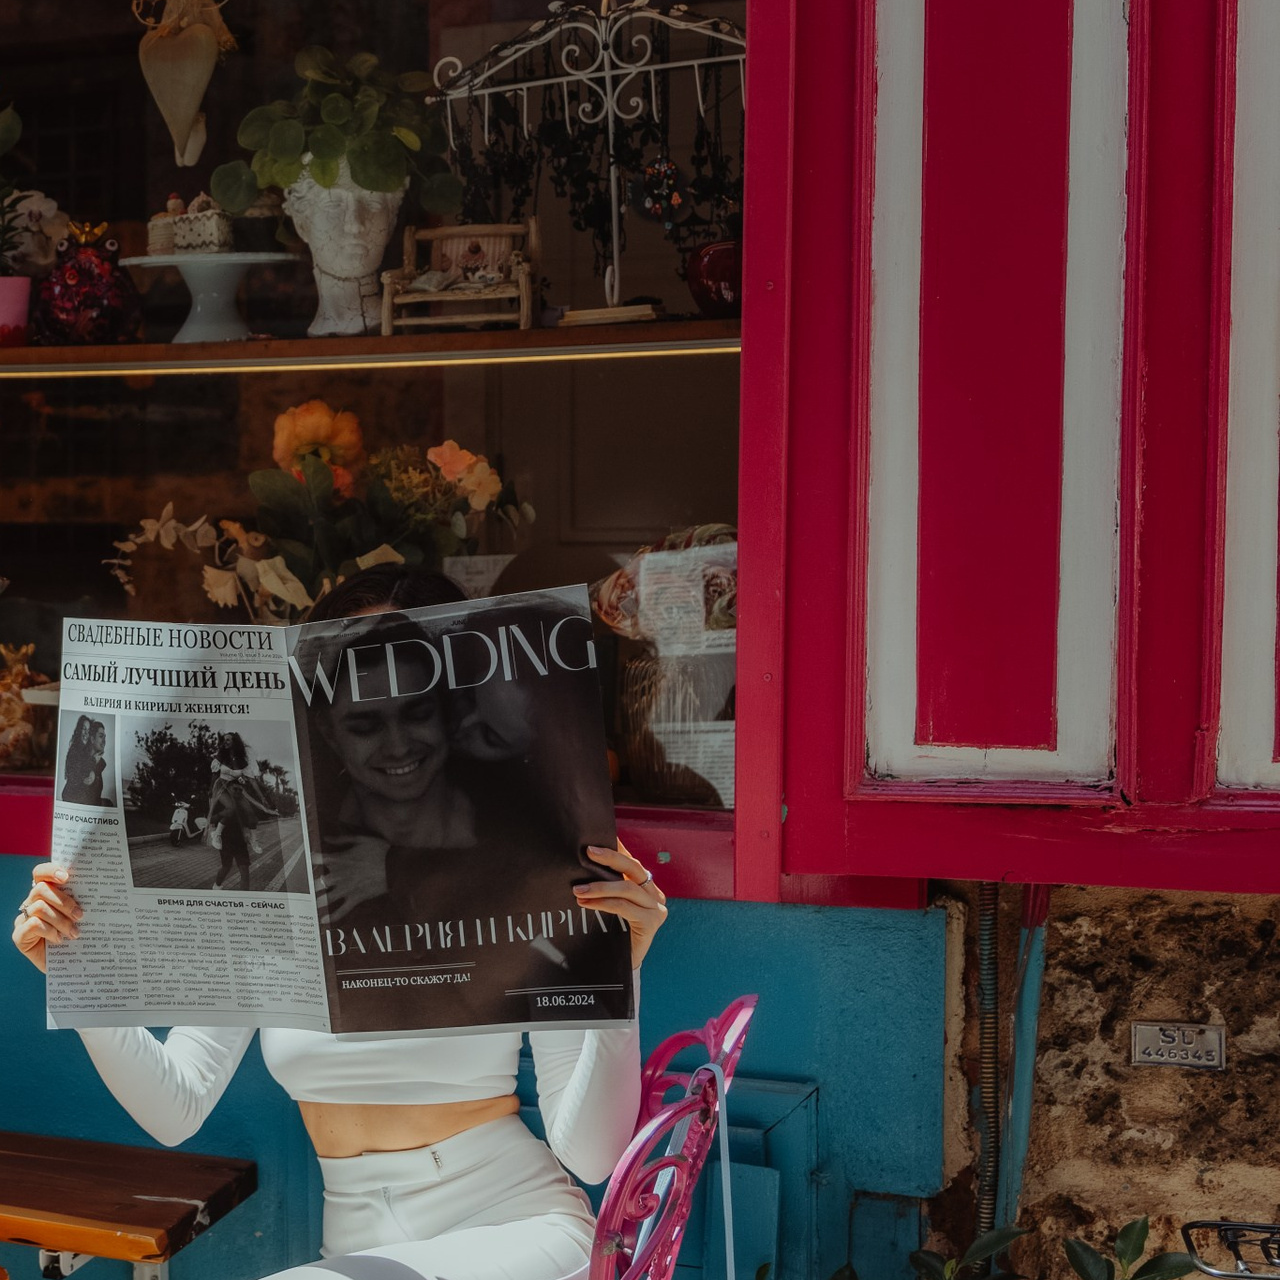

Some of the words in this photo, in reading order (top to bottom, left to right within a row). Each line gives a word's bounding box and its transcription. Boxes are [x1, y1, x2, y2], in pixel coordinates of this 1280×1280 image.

[67, 623, 164, 647] СВАДЕБНЫЕ
[168, 628, 274, 651] НОВОСТИ
[287, 615, 597, 707] WEDDING
[63, 661, 118, 684] САМЫЙ
[121, 665, 218, 689] ЛУЧШИЙ
[223, 670, 286, 692] ДЕНЬ
[83, 696, 122, 709] ВАЛЕРИЯ
[124, 700, 132, 710] И
[134, 700, 182, 713] КИРИЛЛ
[184, 702, 250, 715] ЖЕНЯТСЯ!
[74, 815, 119, 826] СЧАСТЛИВО
[157, 898, 185, 906] ВРЕМЯ
[186, 899, 204, 908] ДЛЯ
[205, 900, 244, 908] СЧАСТЬЯ
[250, 900, 286, 910] СЕЙЧАС
[342, 976, 409, 989] НАКОНЕЦ-ТО
[410, 974, 452, 986] СКАЖУТ
[453, 973, 471, 984] ДА!
[536, 994, 595, 1008] 18.06.2024
[1160, 1029, 1196, 1046] SU
[1142, 1046, 1216, 1062] 446345
